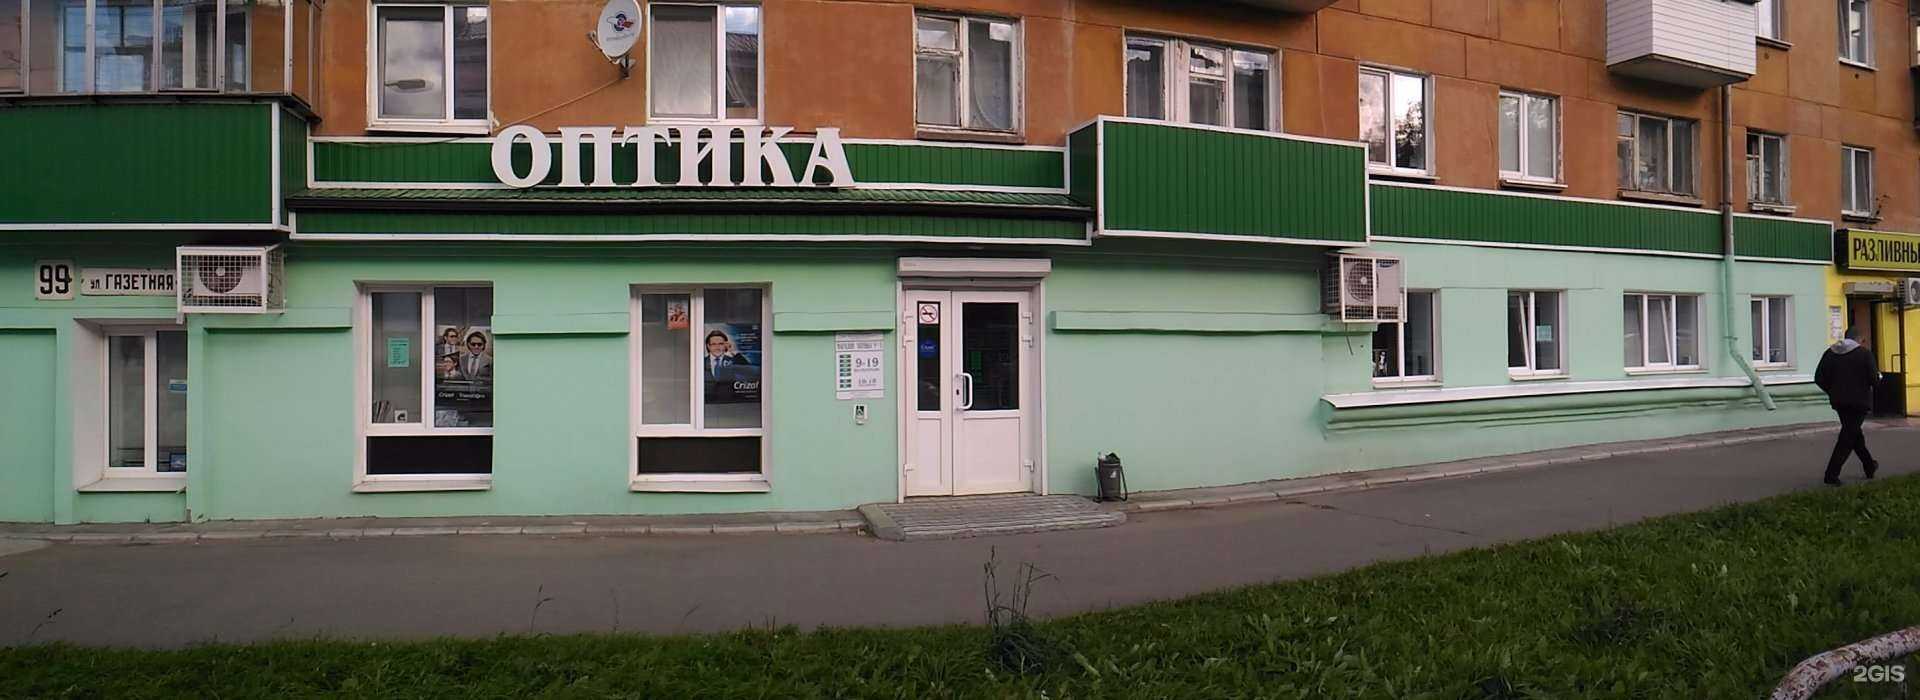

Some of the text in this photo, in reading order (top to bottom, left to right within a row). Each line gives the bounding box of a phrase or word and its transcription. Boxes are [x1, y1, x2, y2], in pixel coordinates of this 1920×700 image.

[491, 125, 856, 188] ОПТИКА
[40, 264, 70, 294] 99
[105, 274, 174, 290] ГАЗЕТНАЯ
[855, 357, 879, 368] 9-19
[733, 381, 759, 390] Crizal
